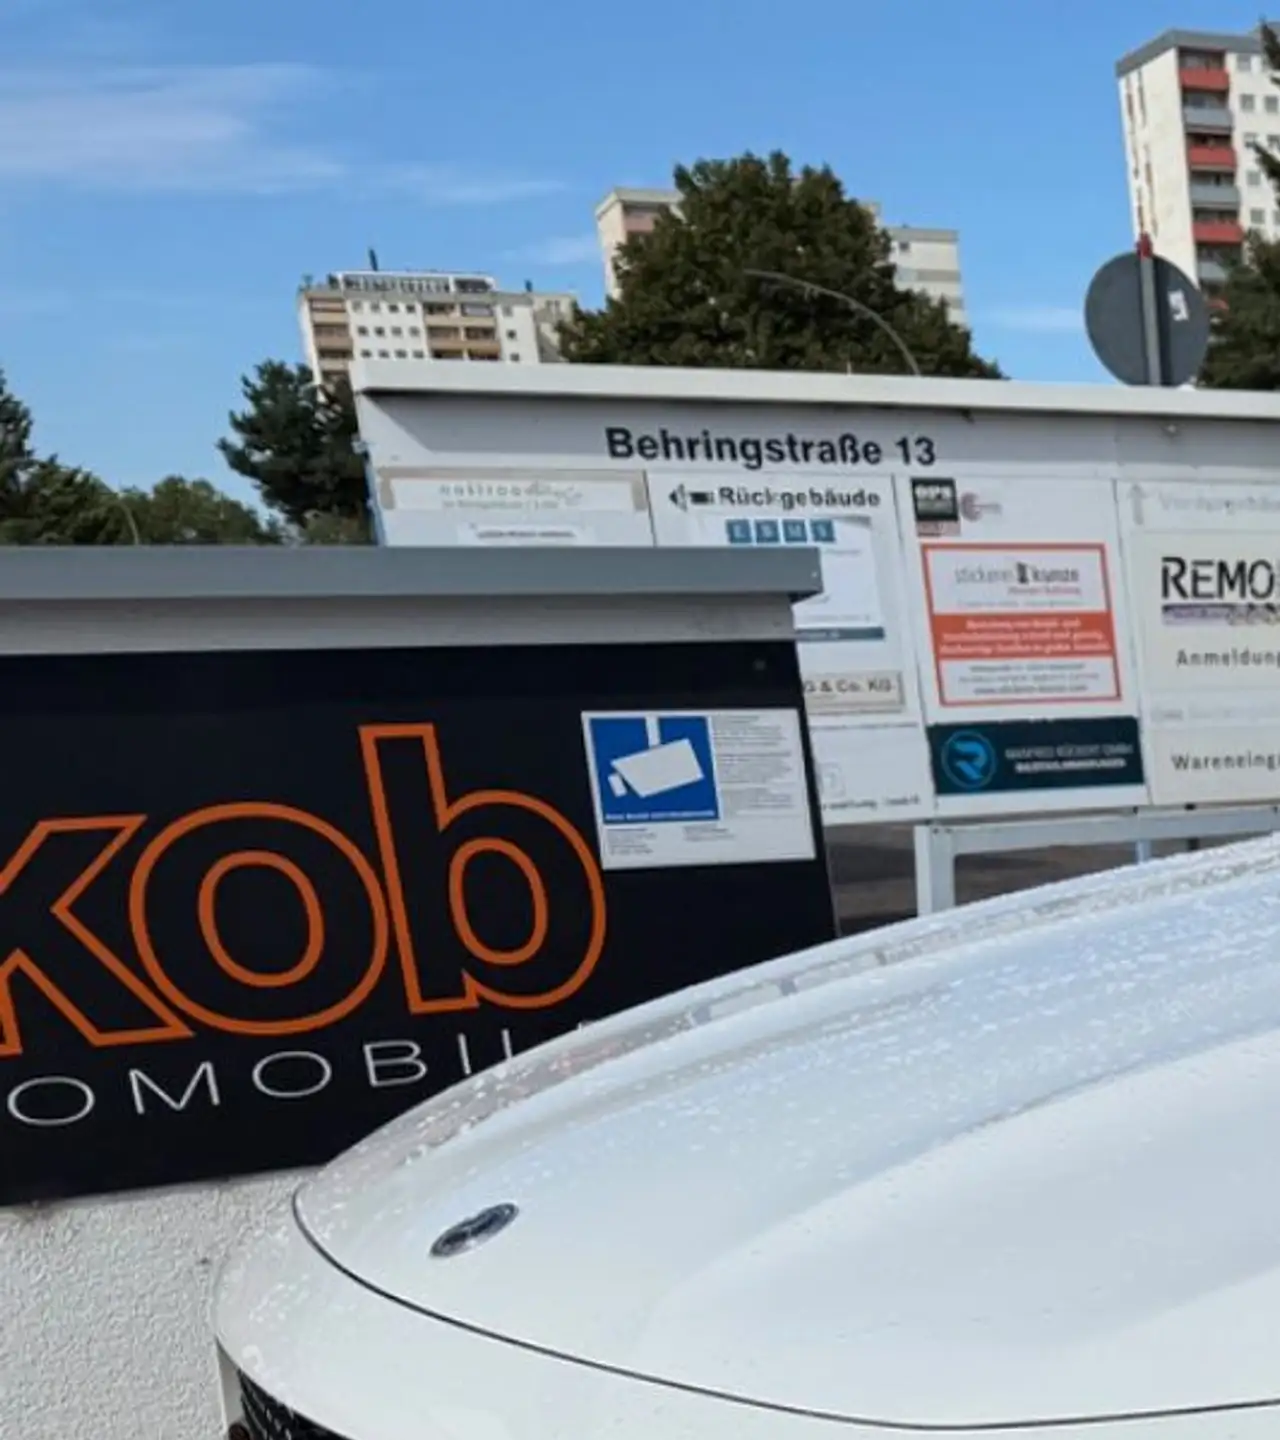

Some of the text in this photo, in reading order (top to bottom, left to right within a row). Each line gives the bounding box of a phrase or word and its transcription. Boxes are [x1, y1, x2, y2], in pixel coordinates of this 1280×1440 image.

[605, 427, 936, 470] Behringstraße 13
[718, 486, 881, 511] Rückgebäude
[1161, 556, 1275, 599] REMO
[0, 723, 606, 1055] kob
